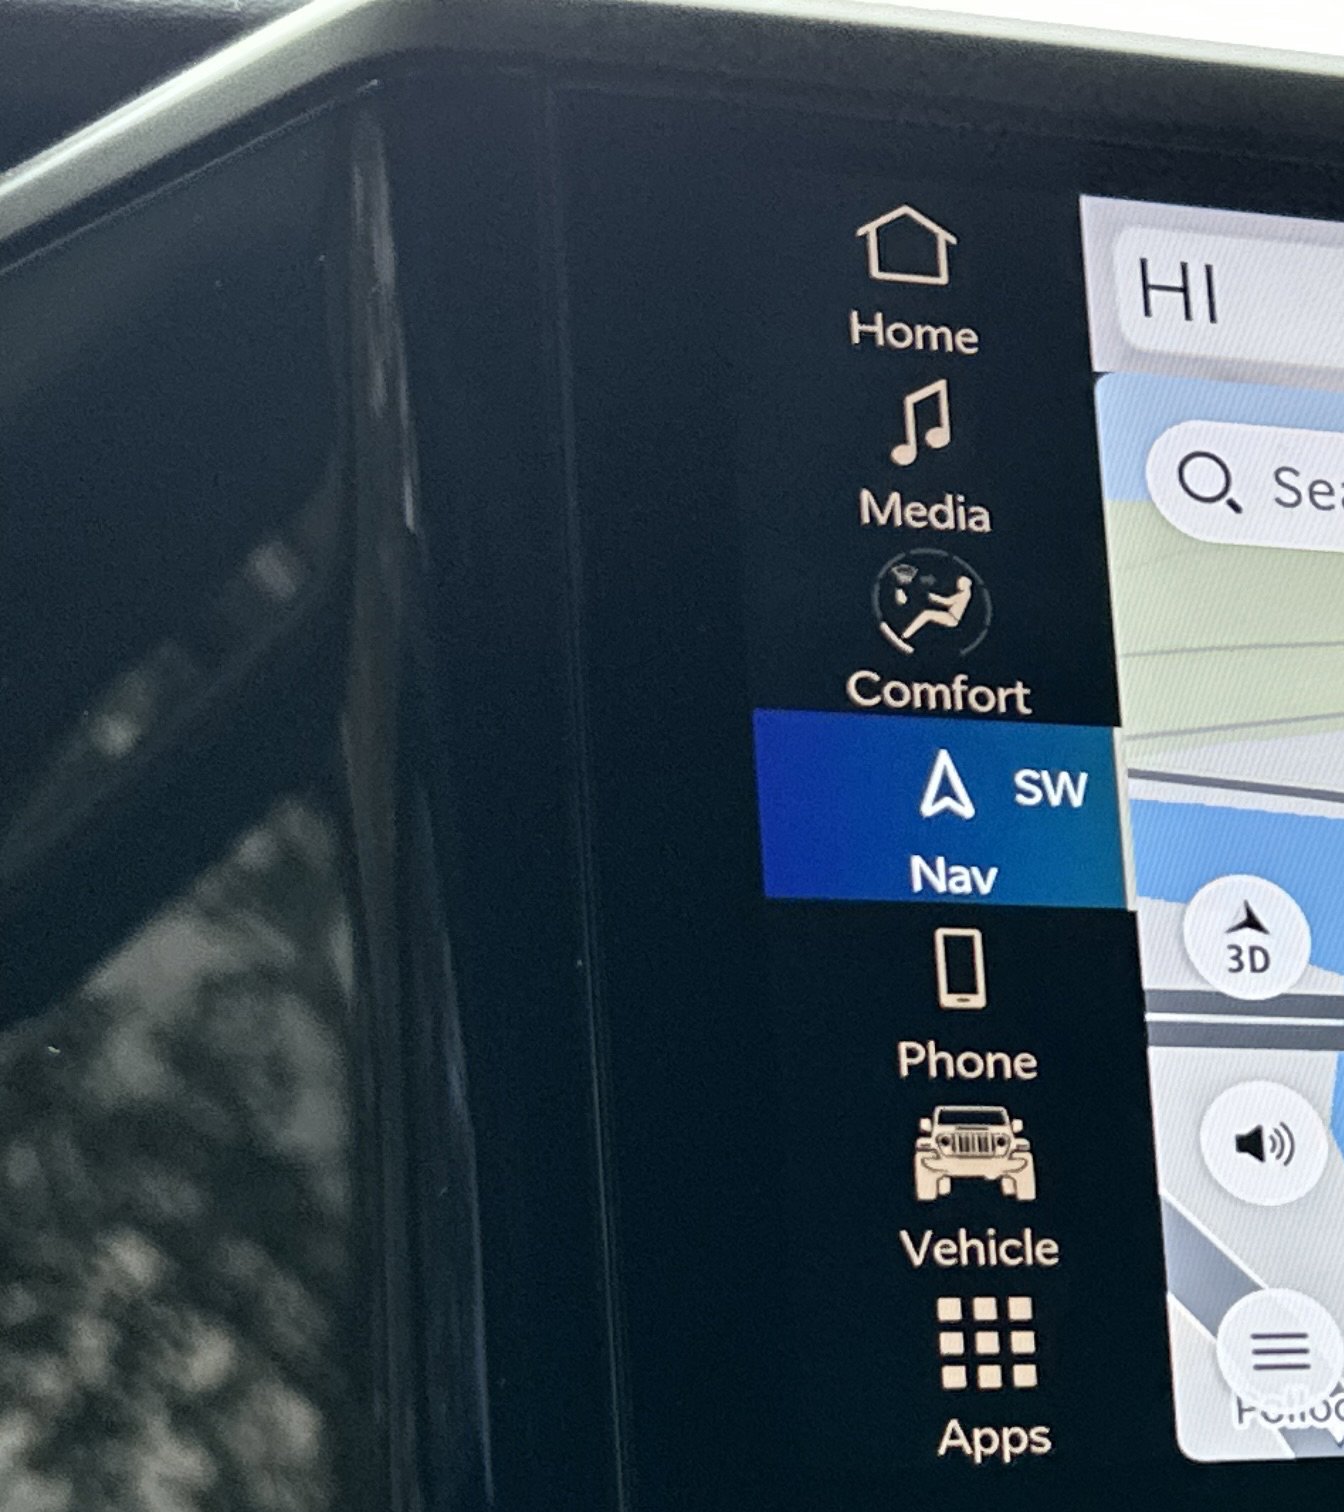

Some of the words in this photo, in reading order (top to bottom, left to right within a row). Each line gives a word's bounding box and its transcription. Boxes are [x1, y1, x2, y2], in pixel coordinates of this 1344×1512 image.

[1138, 256, 1219, 325] HI
[849, 309, 980, 355] Home
[859, 487, 992, 534] Media
[845, 669, 1034, 716] Comfort
[1013, 768, 1090, 809] SW
[909, 853, 999, 896] Nav
[1226, 943, 1272, 975] 3D
[897, 1039, 1039, 1081] Phone
[898, 1226, 1060, 1268] Vehicle
[936, 1417, 1053, 1465] Apps
